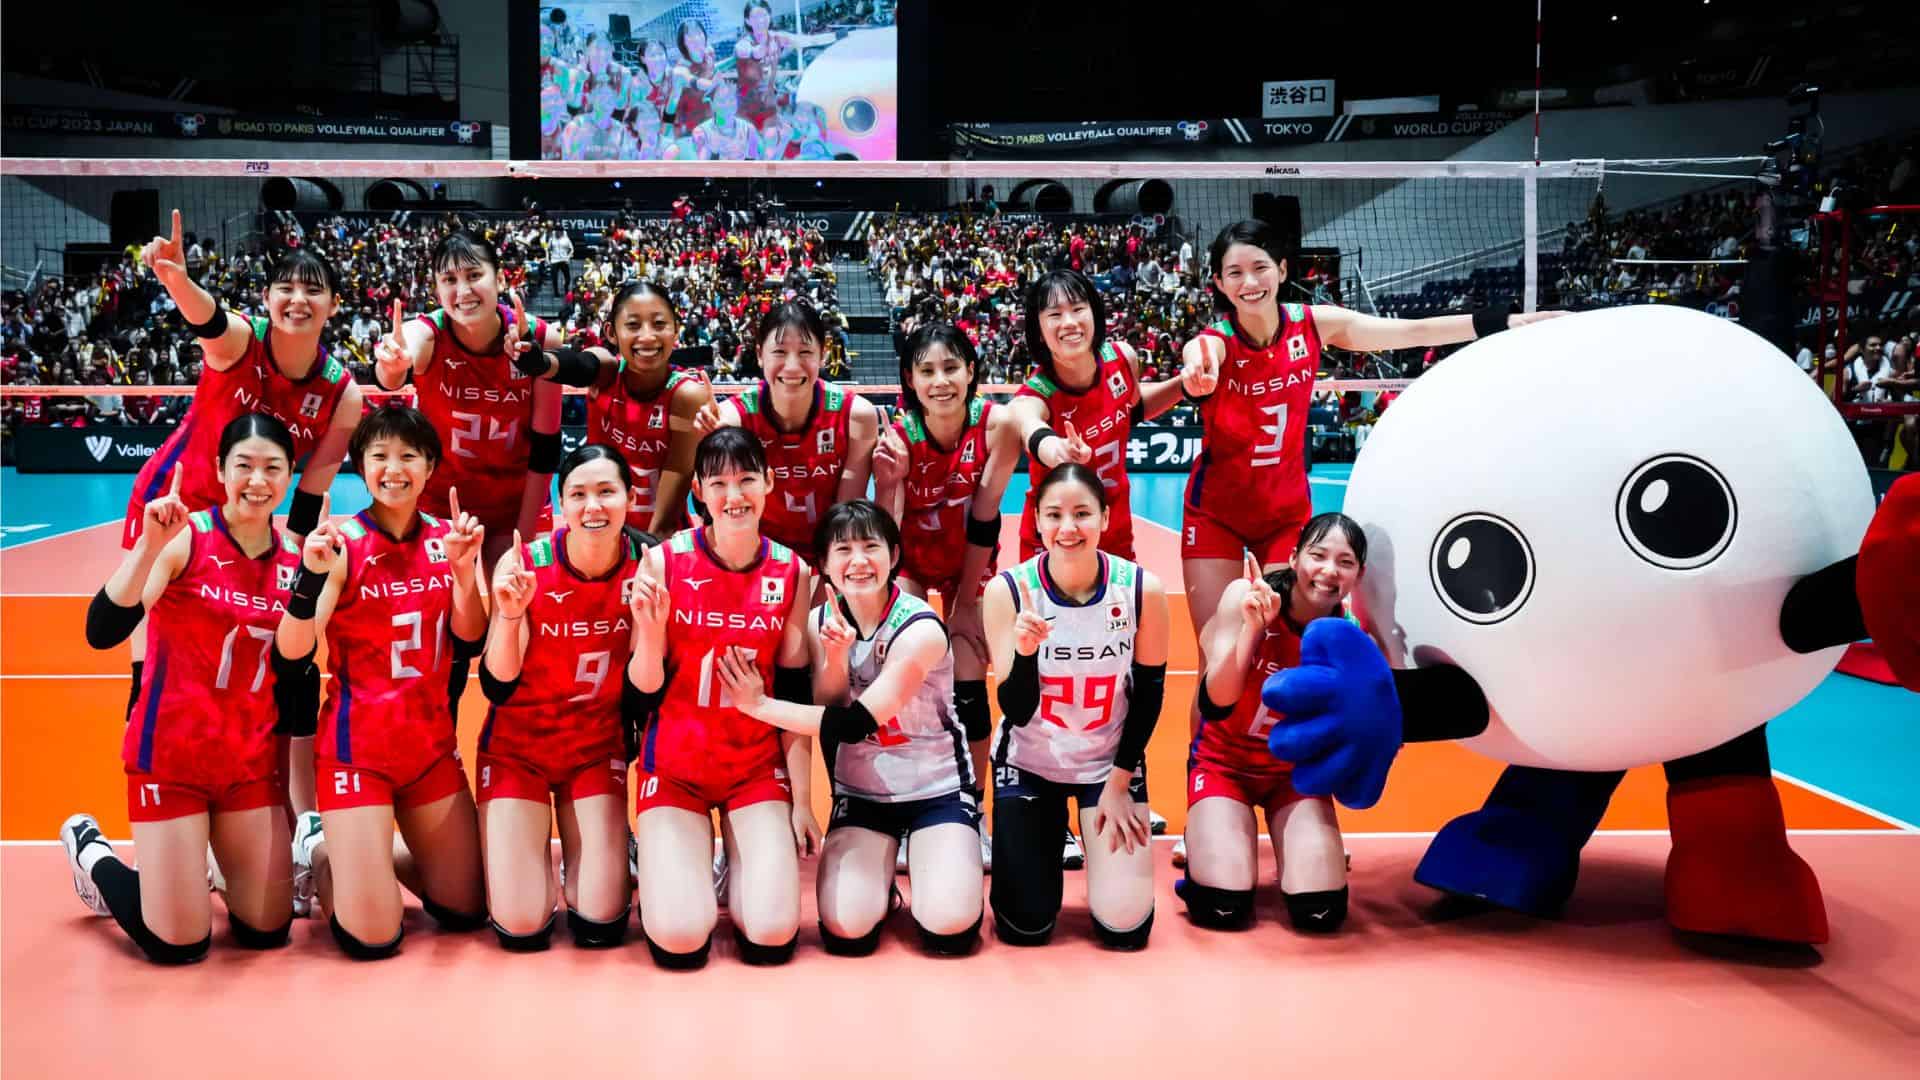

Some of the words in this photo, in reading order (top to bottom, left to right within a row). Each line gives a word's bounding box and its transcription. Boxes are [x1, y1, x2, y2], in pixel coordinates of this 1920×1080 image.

[1270, 86, 1327, 105] 渋谷口
[106, 120, 153, 134] JAPAN
[234, 121, 265, 133] ROAD
[267, 122, 282, 133] TO
[284, 123, 314, 134] PARIS
[317, 123, 388, 136] VOLLEYBALL
[389, 126, 446, 137] QUALIFIER
[1016, 132, 1045, 145] PARIS
[1047, 129, 1115, 142] VOLLEYBALL
[1116, 126, 1172, 137] QUALIFIER
[1263, 121, 1313, 136] TOKYO
[1393, 120, 1448, 136] WORLD
[1451, 119, 1481, 135] CUP
[440, 381, 532, 403] NISSAN
[1228, 368, 1313, 396] NISSAN
[1085, 403, 1136, 439] SSAN
[1254, 403, 1289, 453] 3
[451, 411, 520, 459] 24
[116, 444, 162, 458] Volley
[775, 459, 841, 479] SSAN
[783, 489, 817, 523] 4
[200, 584, 288, 613] NISSA
[540, 617, 631, 638] NISSA
[674, 608, 785, 632] NISSAN
[391, 610, 445, 680] 21
[1044, 638, 1132, 661] ISSAN
[215, 623, 275, 693] 17
[567, 650, 611, 702] 9
[1040, 675, 1117, 732] 29
[334, 770, 361, 795] 21
[640, 776, 659, 801] 10
[995, 766, 1020, 788] 29
[139, 783, 162, 808] 17
